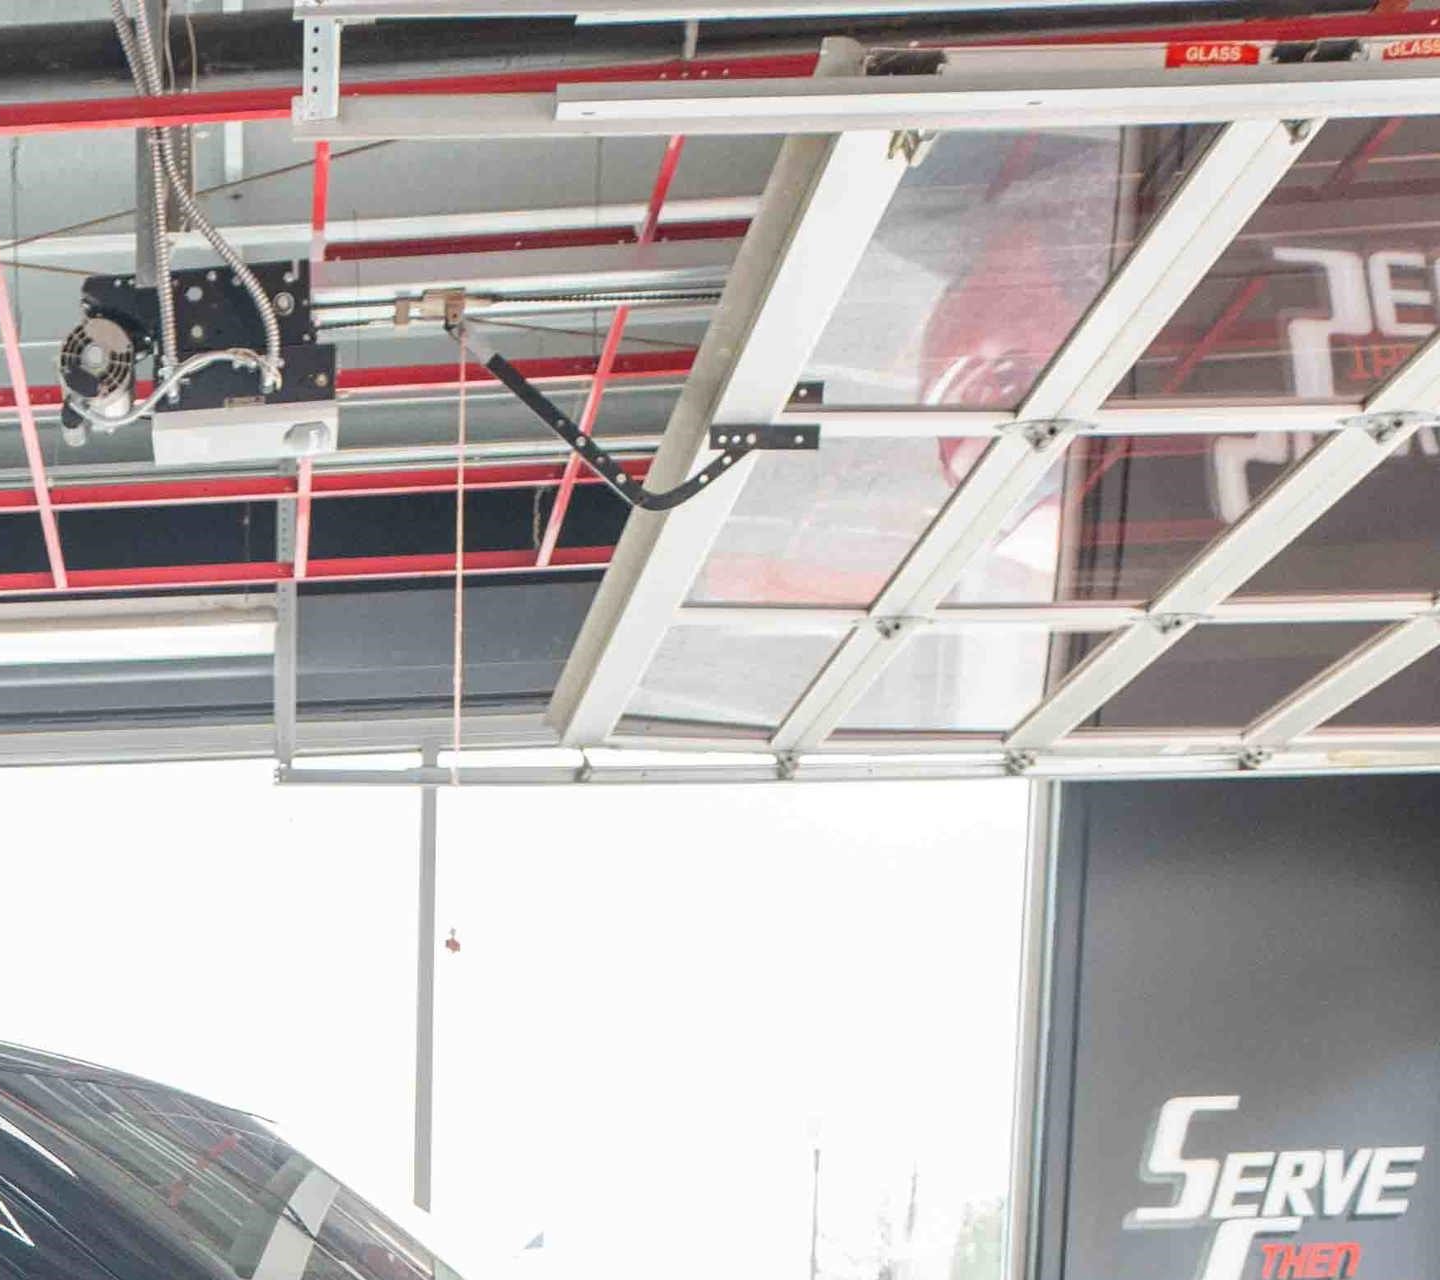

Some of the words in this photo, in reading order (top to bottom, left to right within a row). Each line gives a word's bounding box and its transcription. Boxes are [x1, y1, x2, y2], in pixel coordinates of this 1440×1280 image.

[1185, 46, 1242, 62] GLASS
[1123, 1095, 1425, 1229] SERVE
[1261, 1242, 1361, 1280] THEN
